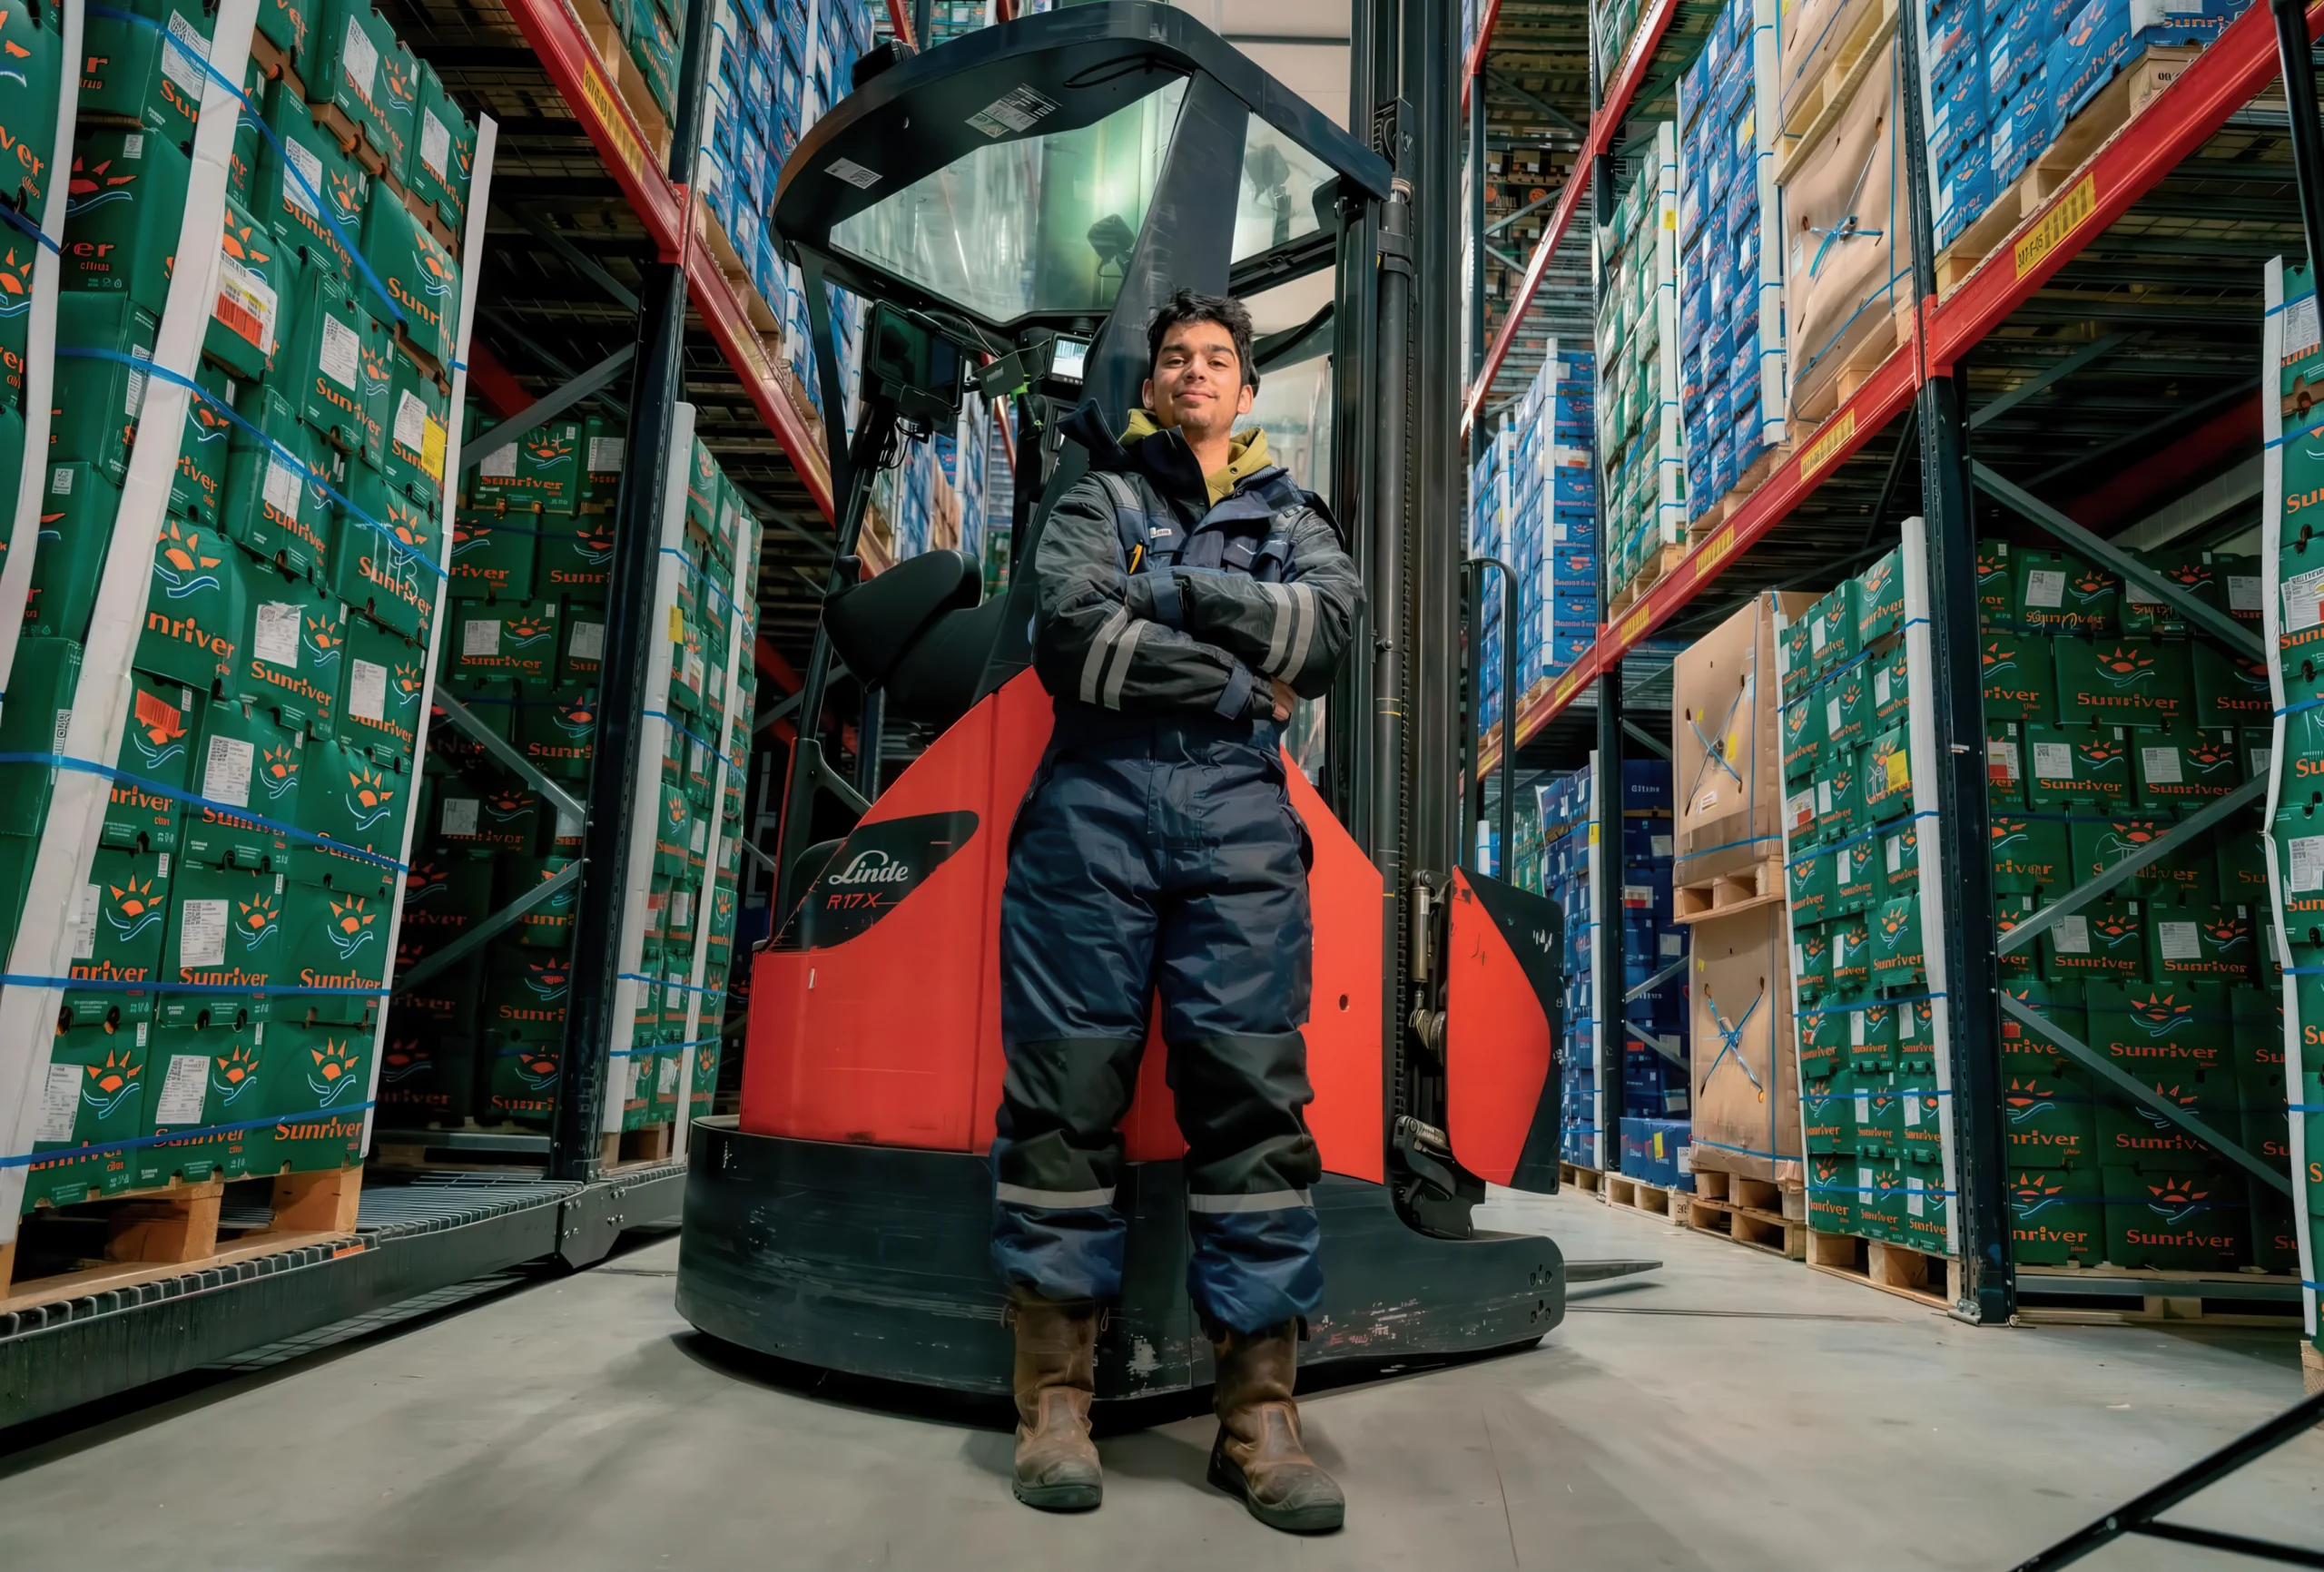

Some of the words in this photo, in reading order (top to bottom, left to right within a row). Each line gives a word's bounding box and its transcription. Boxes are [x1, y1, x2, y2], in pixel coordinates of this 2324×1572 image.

[282, 196, 353, 265] Sunriver
[316, 378, 381, 437] Sunriver
[481, 477, 564, 490] Sunriver
[262, 500, 326, 554] Sunriver
[358, 556, 432, 617] Sunriver
[460, 654, 542, 669] Sunriver
[251, 661, 331, 707] Sunriver
[2077, 693, 2179, 709] Sunriver
[2041, 779, 2122, 792] Sunriver
[829, 850, 909, 885] Linde
[2055, 955, 2136, 969] Sunriver
[2164, 959, 2247, 973] Sunriver
[180, 967, 268, 986] Sunriver
[299, 968, 381, 989] Sunriver
[2111, 1043, 2218, 1058] Sunriver
[274, 1116, 362, 1141] Sunriver
[2127, 1229, 2234, 1247] Sunriver
